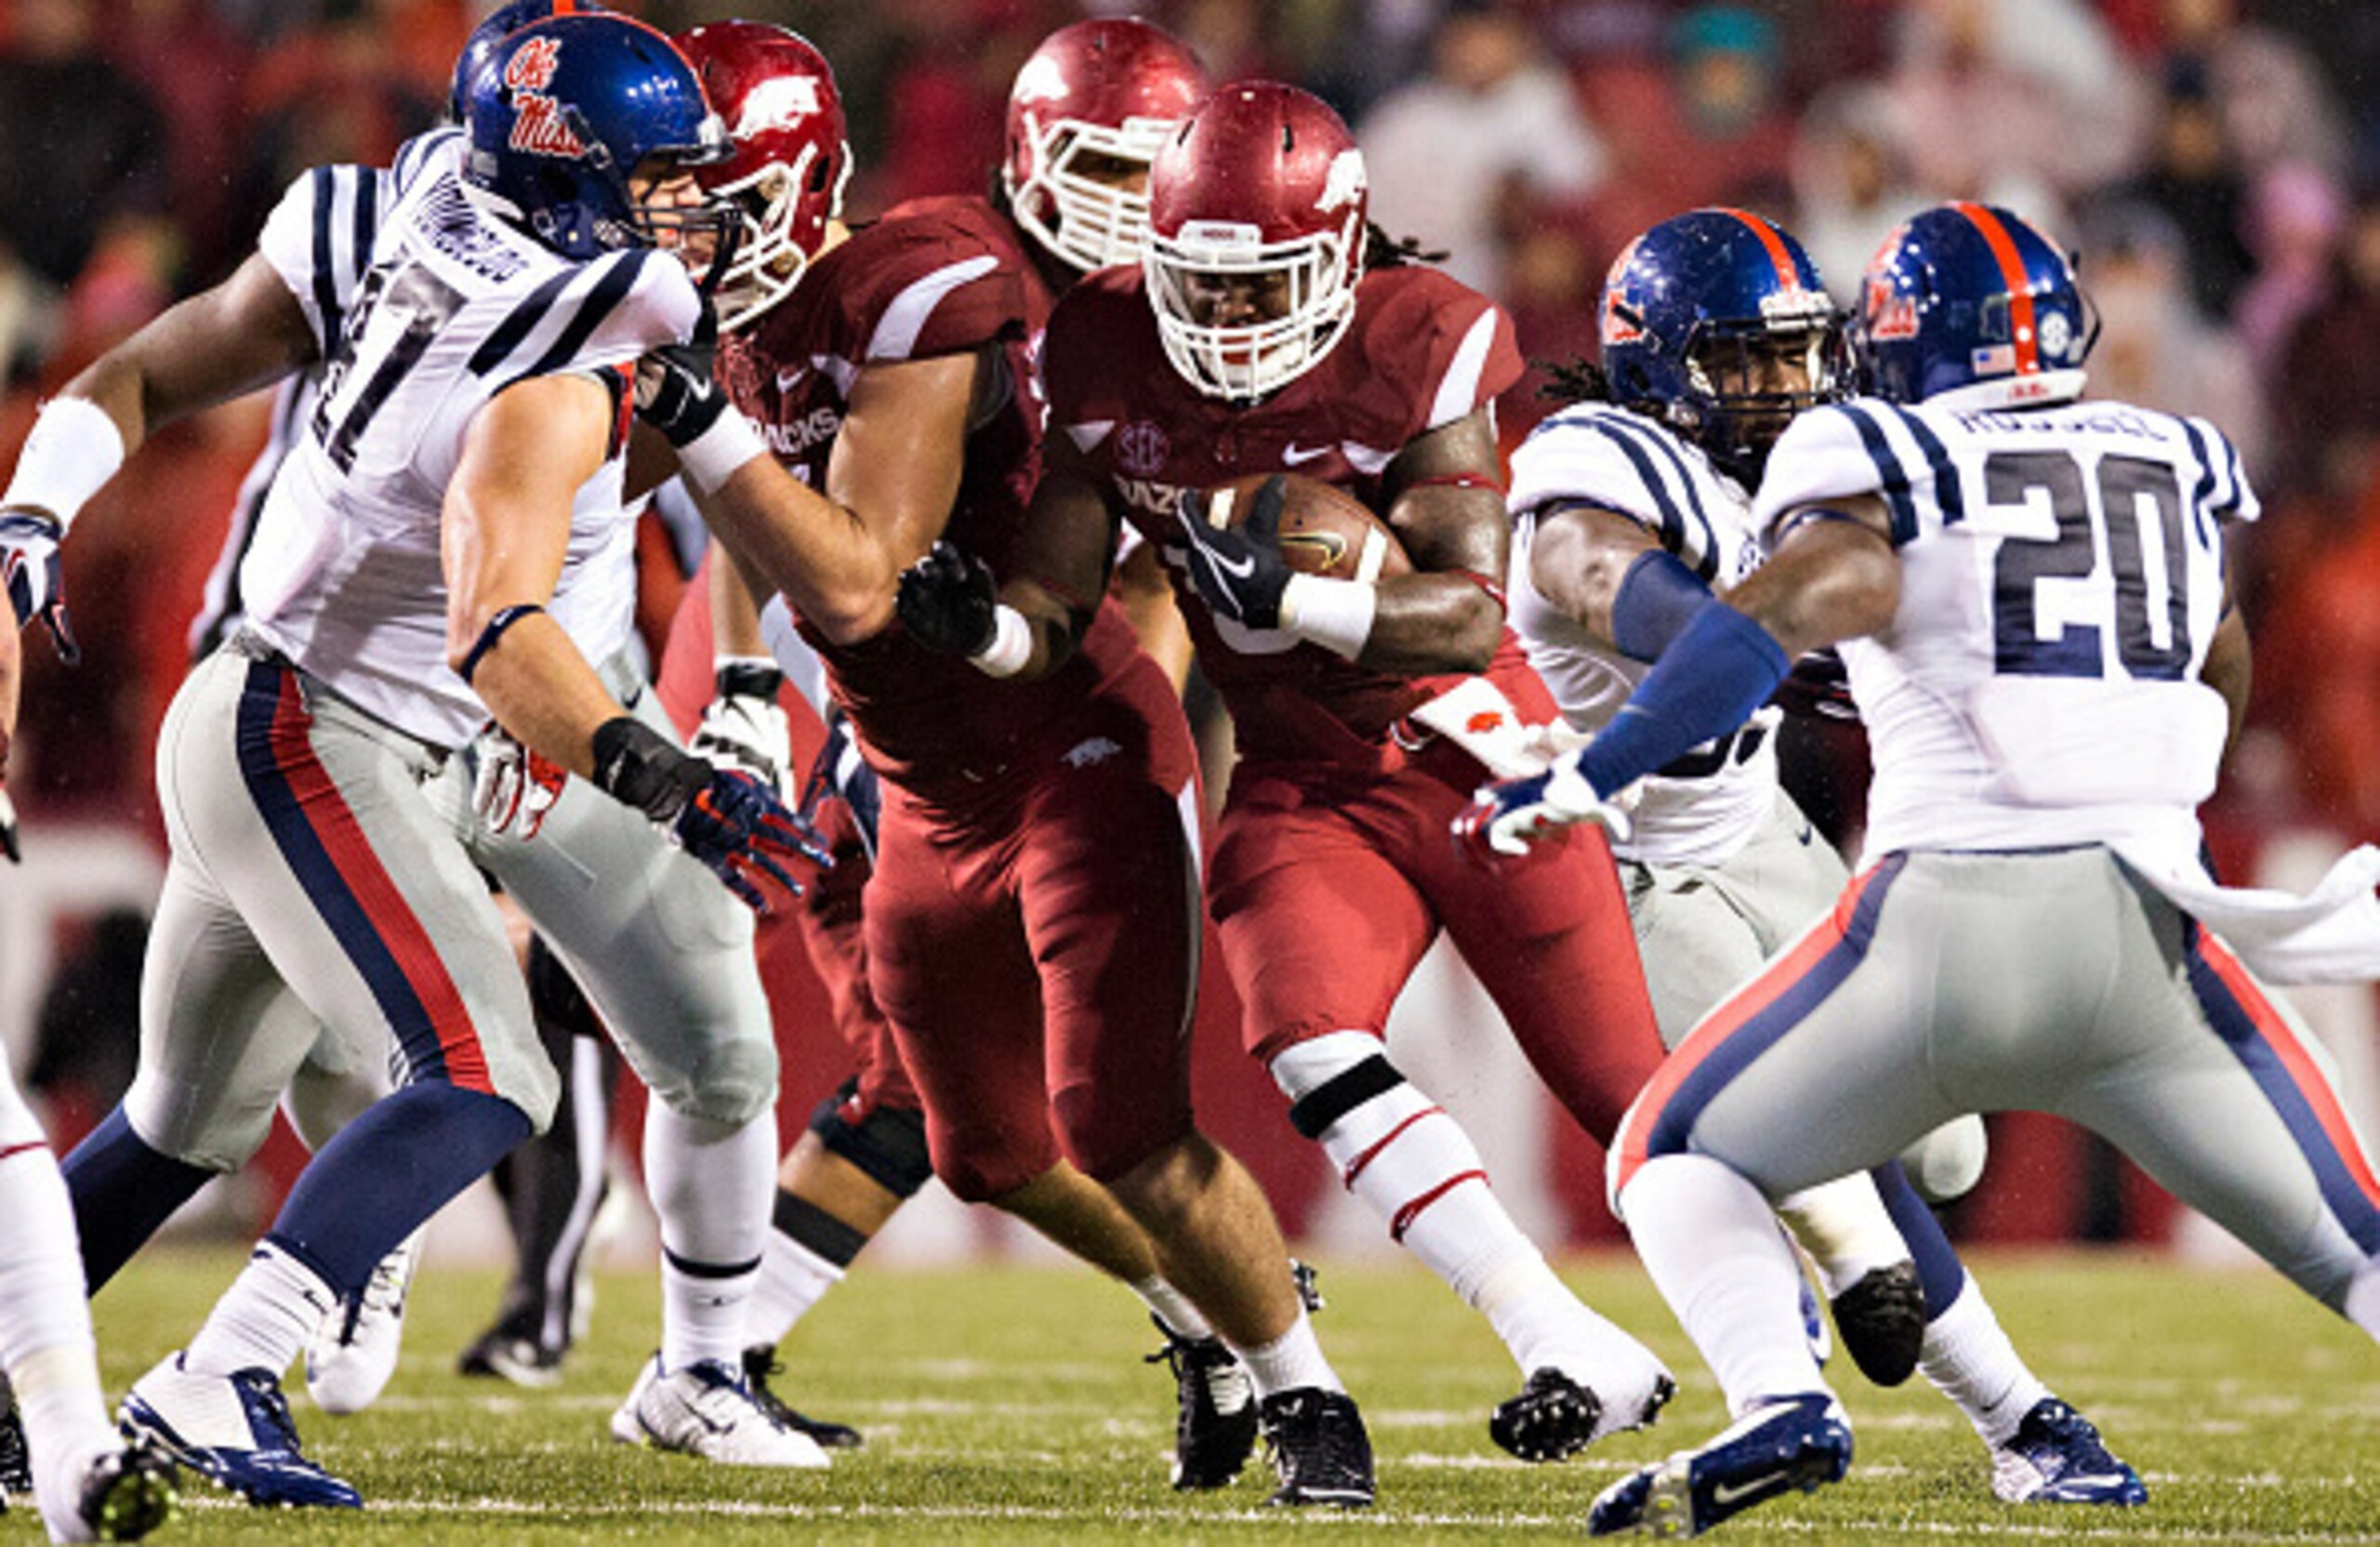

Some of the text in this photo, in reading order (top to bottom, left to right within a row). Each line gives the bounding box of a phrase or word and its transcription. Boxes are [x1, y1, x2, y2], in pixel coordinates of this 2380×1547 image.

[504, 35, 562, 89] Ole
[1119, 424, 1166, 472] SEC
[1983, 449, 2192, 681] 20
